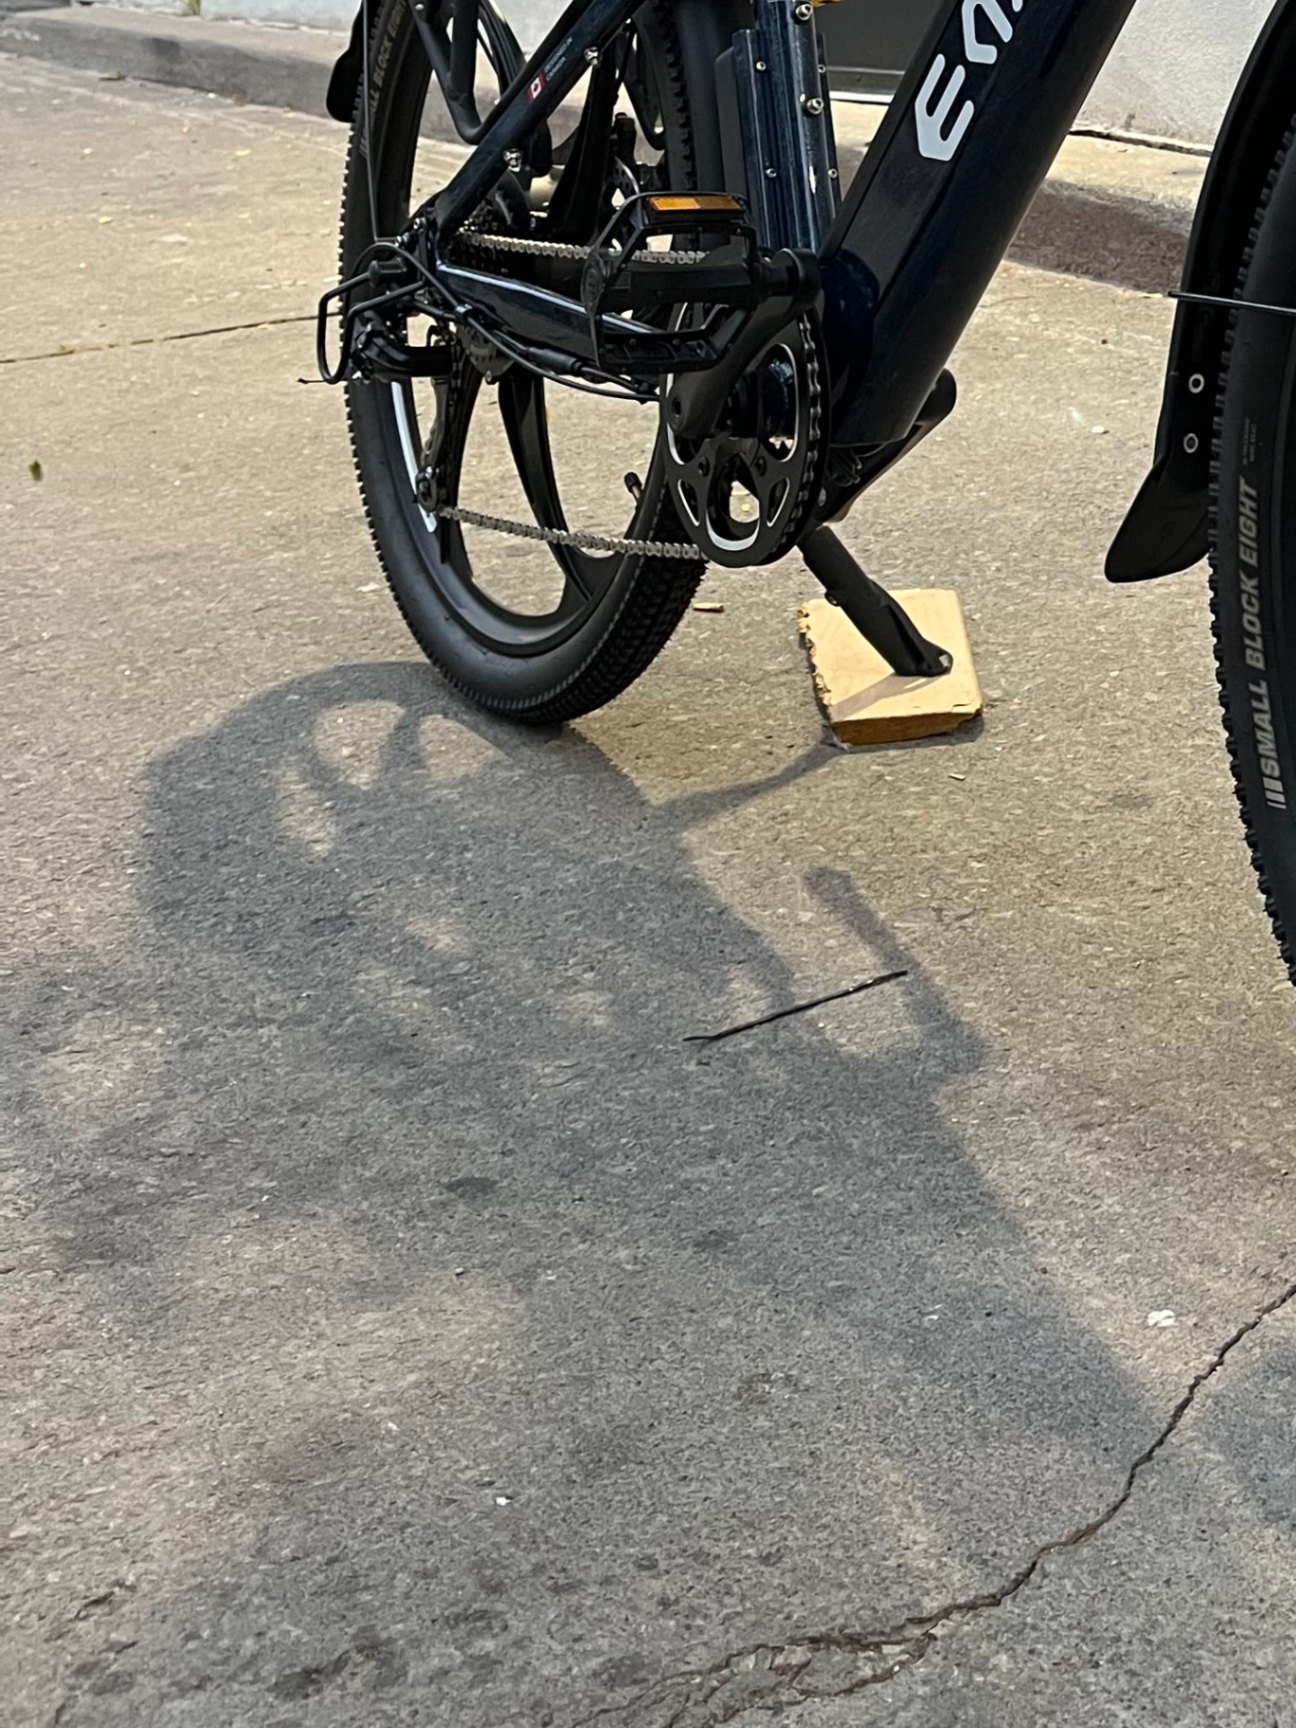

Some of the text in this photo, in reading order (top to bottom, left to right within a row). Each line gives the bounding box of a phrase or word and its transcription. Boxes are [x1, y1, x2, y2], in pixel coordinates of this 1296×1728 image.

[374, 34, 397, 88] BLOCK
[1238, 475, 1259, 569] EIGHT
[1239, 570, 1265, 672] BLOCK
[1248, 678, 1282, 779] SMALL
